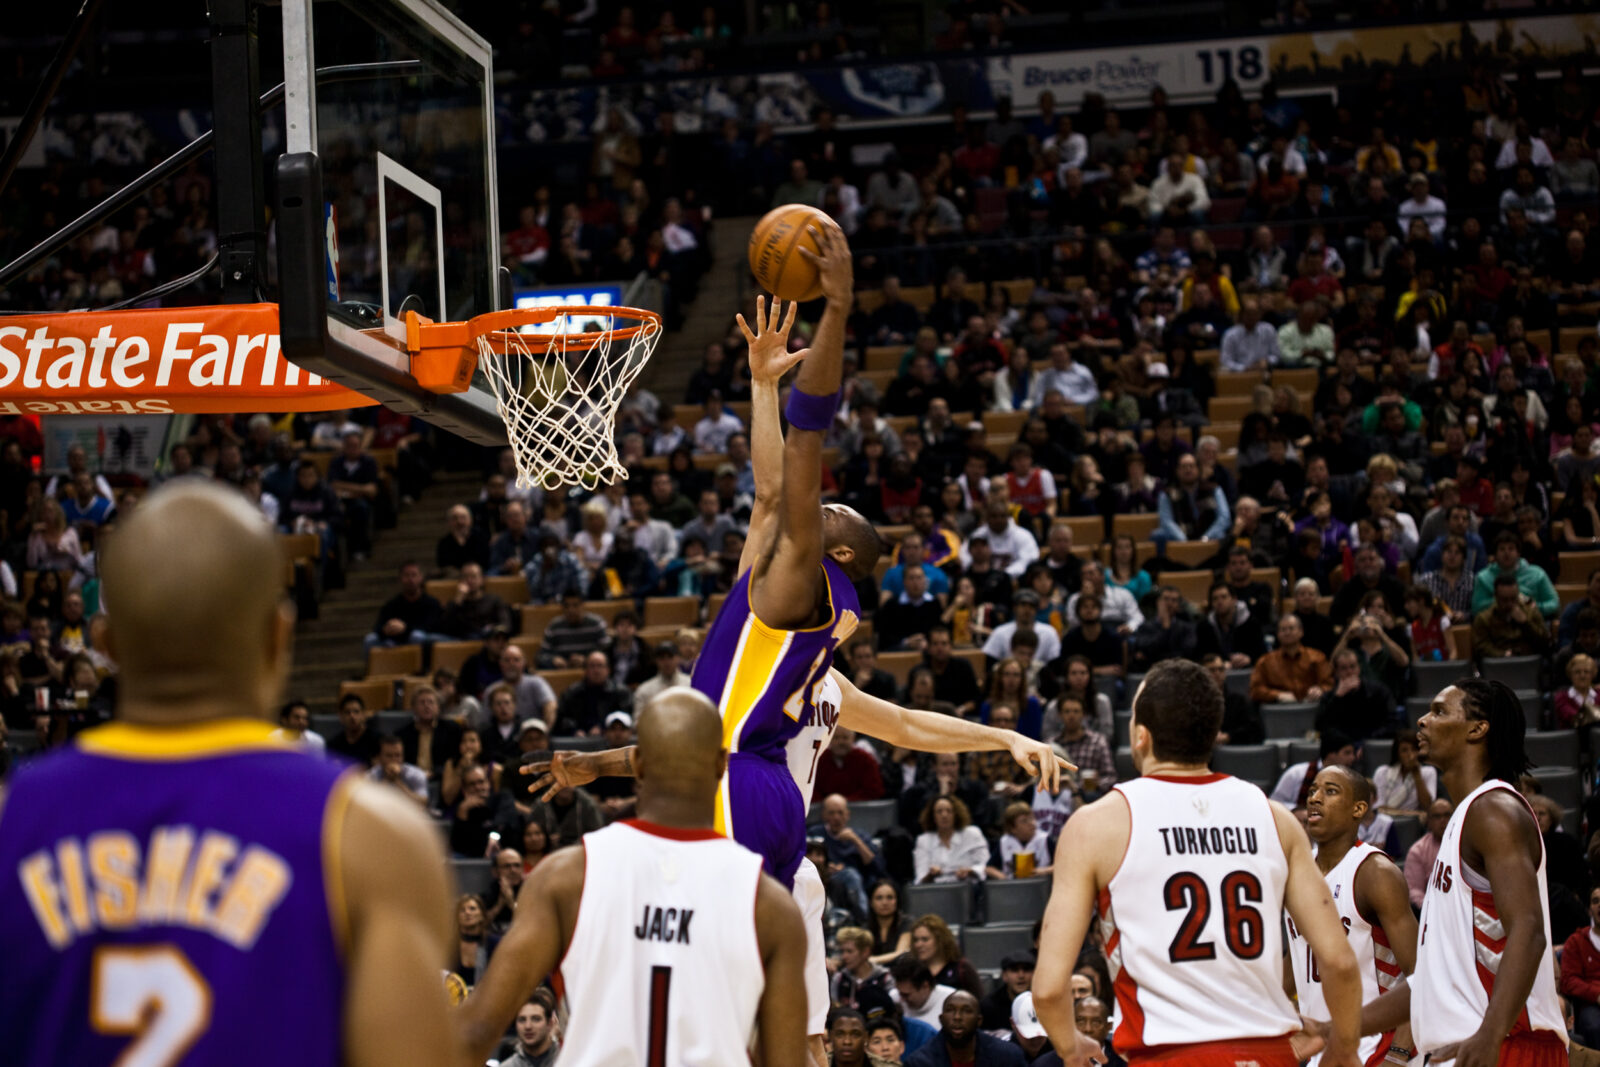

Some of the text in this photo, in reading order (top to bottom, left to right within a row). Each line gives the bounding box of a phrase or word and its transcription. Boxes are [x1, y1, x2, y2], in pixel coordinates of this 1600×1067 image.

[1023, 64, 1092, 88] Bruce
[1096, 54, 1162, 83] Power
[1197, 46, 1264, 84] 118
[0, 324, 150, 389] State
[1158, 826, 1258, 856] TURKOGLU
[18, 824, 293, 951] FISHER
[635, 905, 694, 945] JACK
[1163, 869, 1265, 964] 26
[90, 944, 213, 1067] 2
[647, 964, 672, 1067] 1
